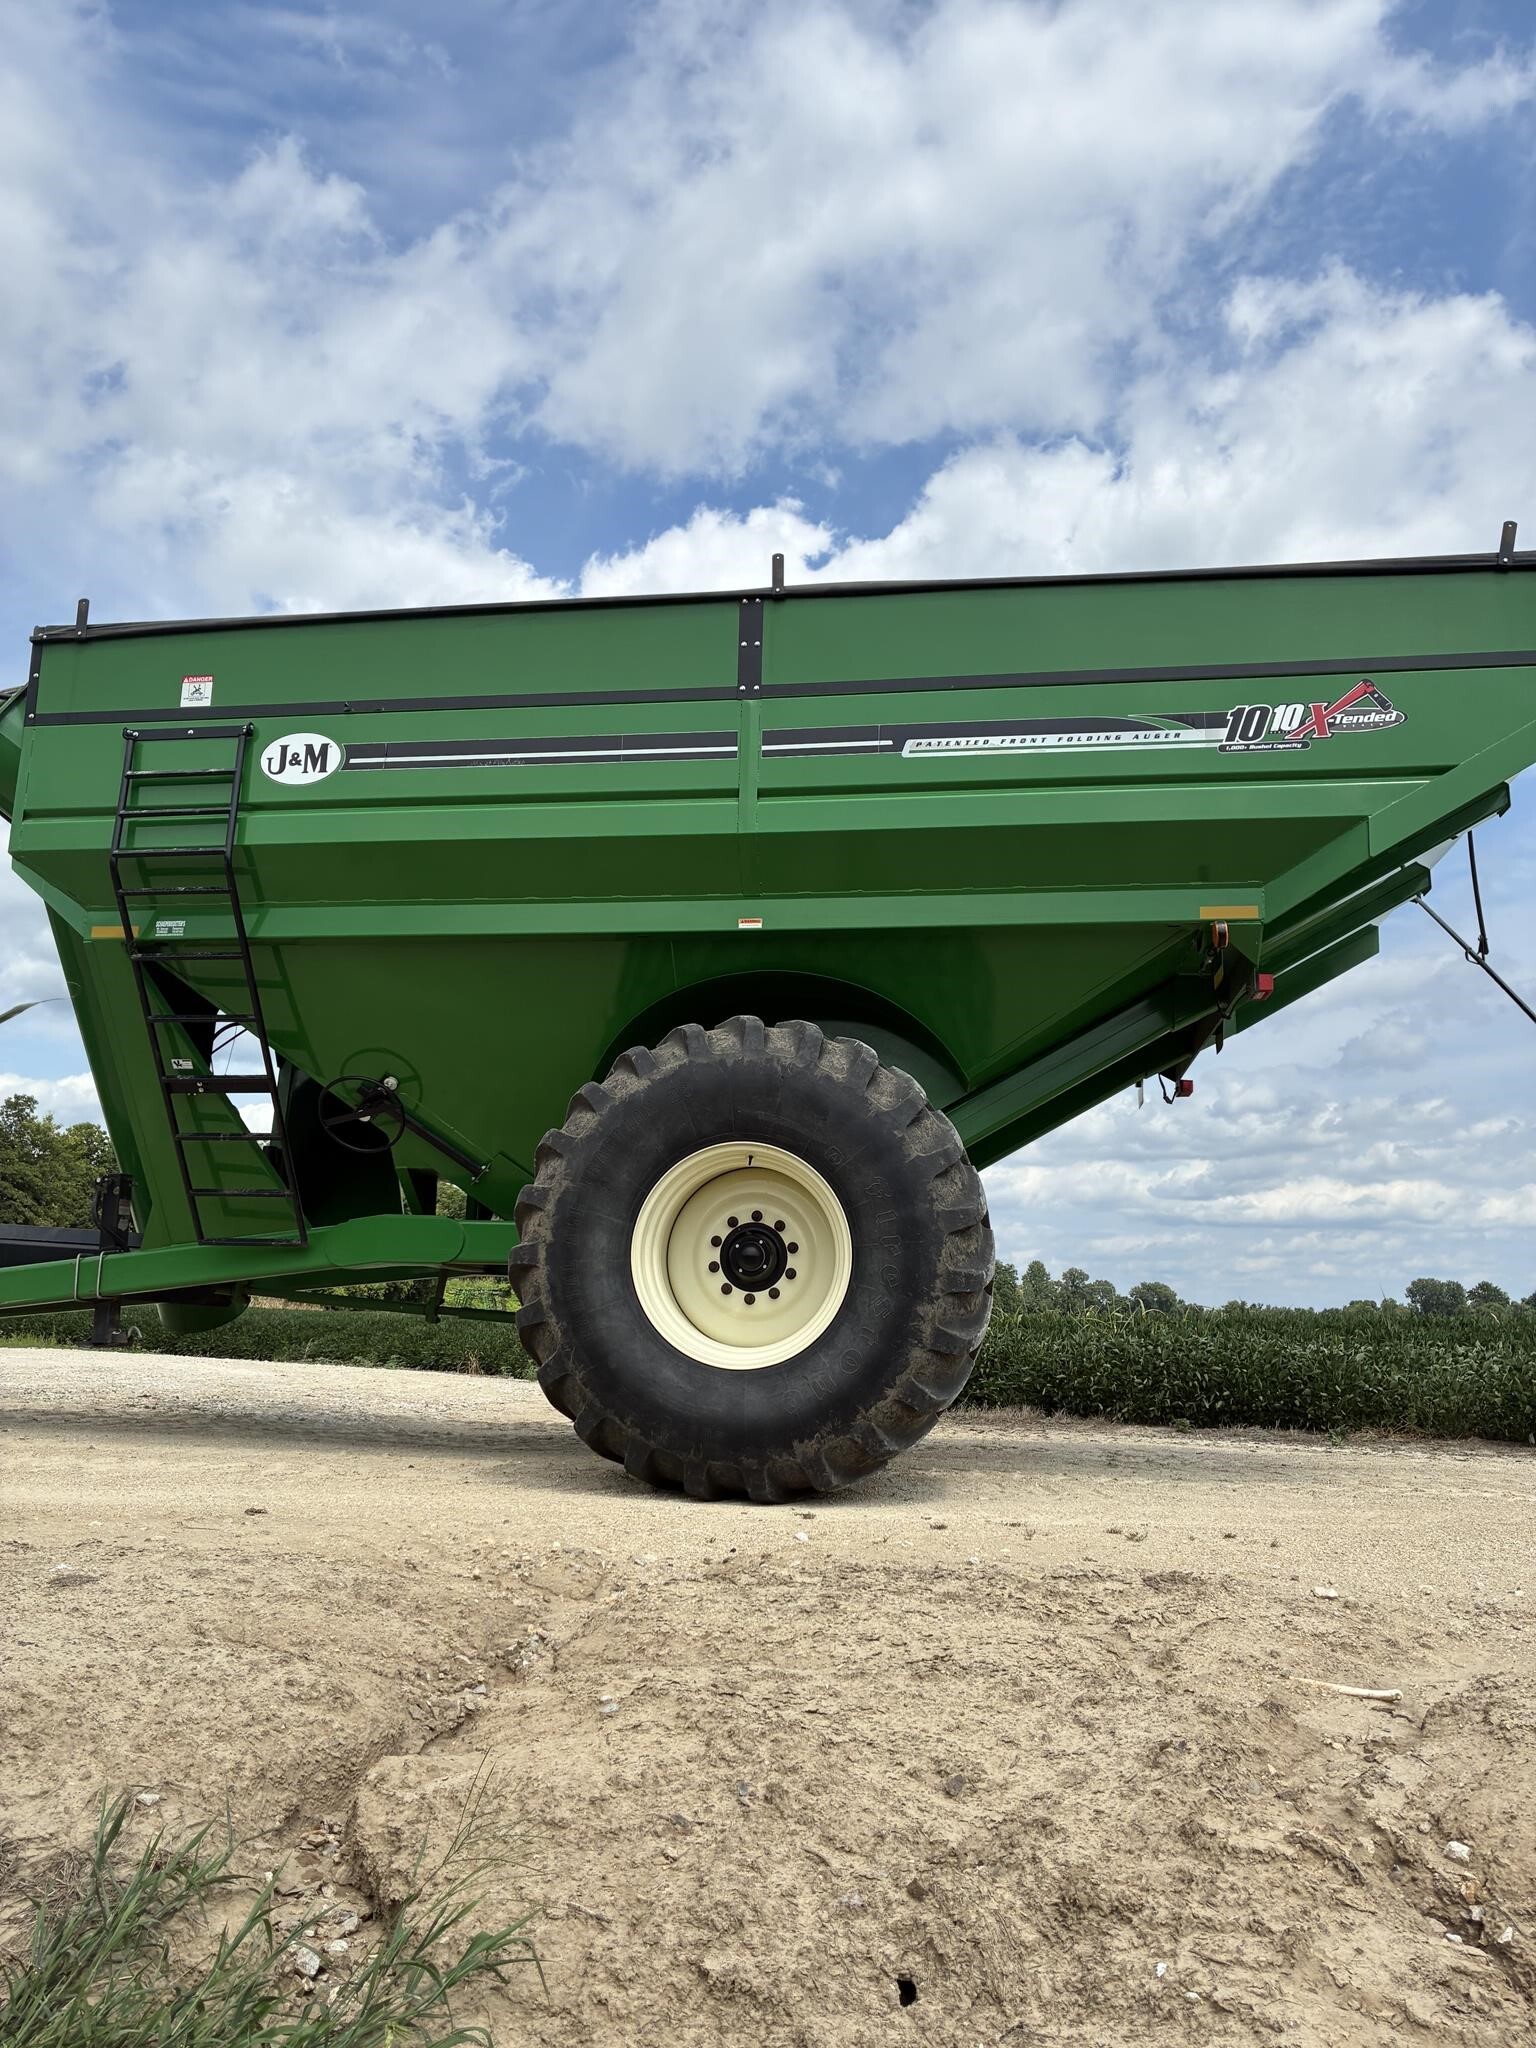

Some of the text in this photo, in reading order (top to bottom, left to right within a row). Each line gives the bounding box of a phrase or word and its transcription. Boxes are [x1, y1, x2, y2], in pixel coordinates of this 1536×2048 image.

[915, 732, 1182, 748] PATENTED FRONT FOLDING AUGER
[1273, 742, 1303, 750] Capacity
[266, 743, 330, 775] J&M
